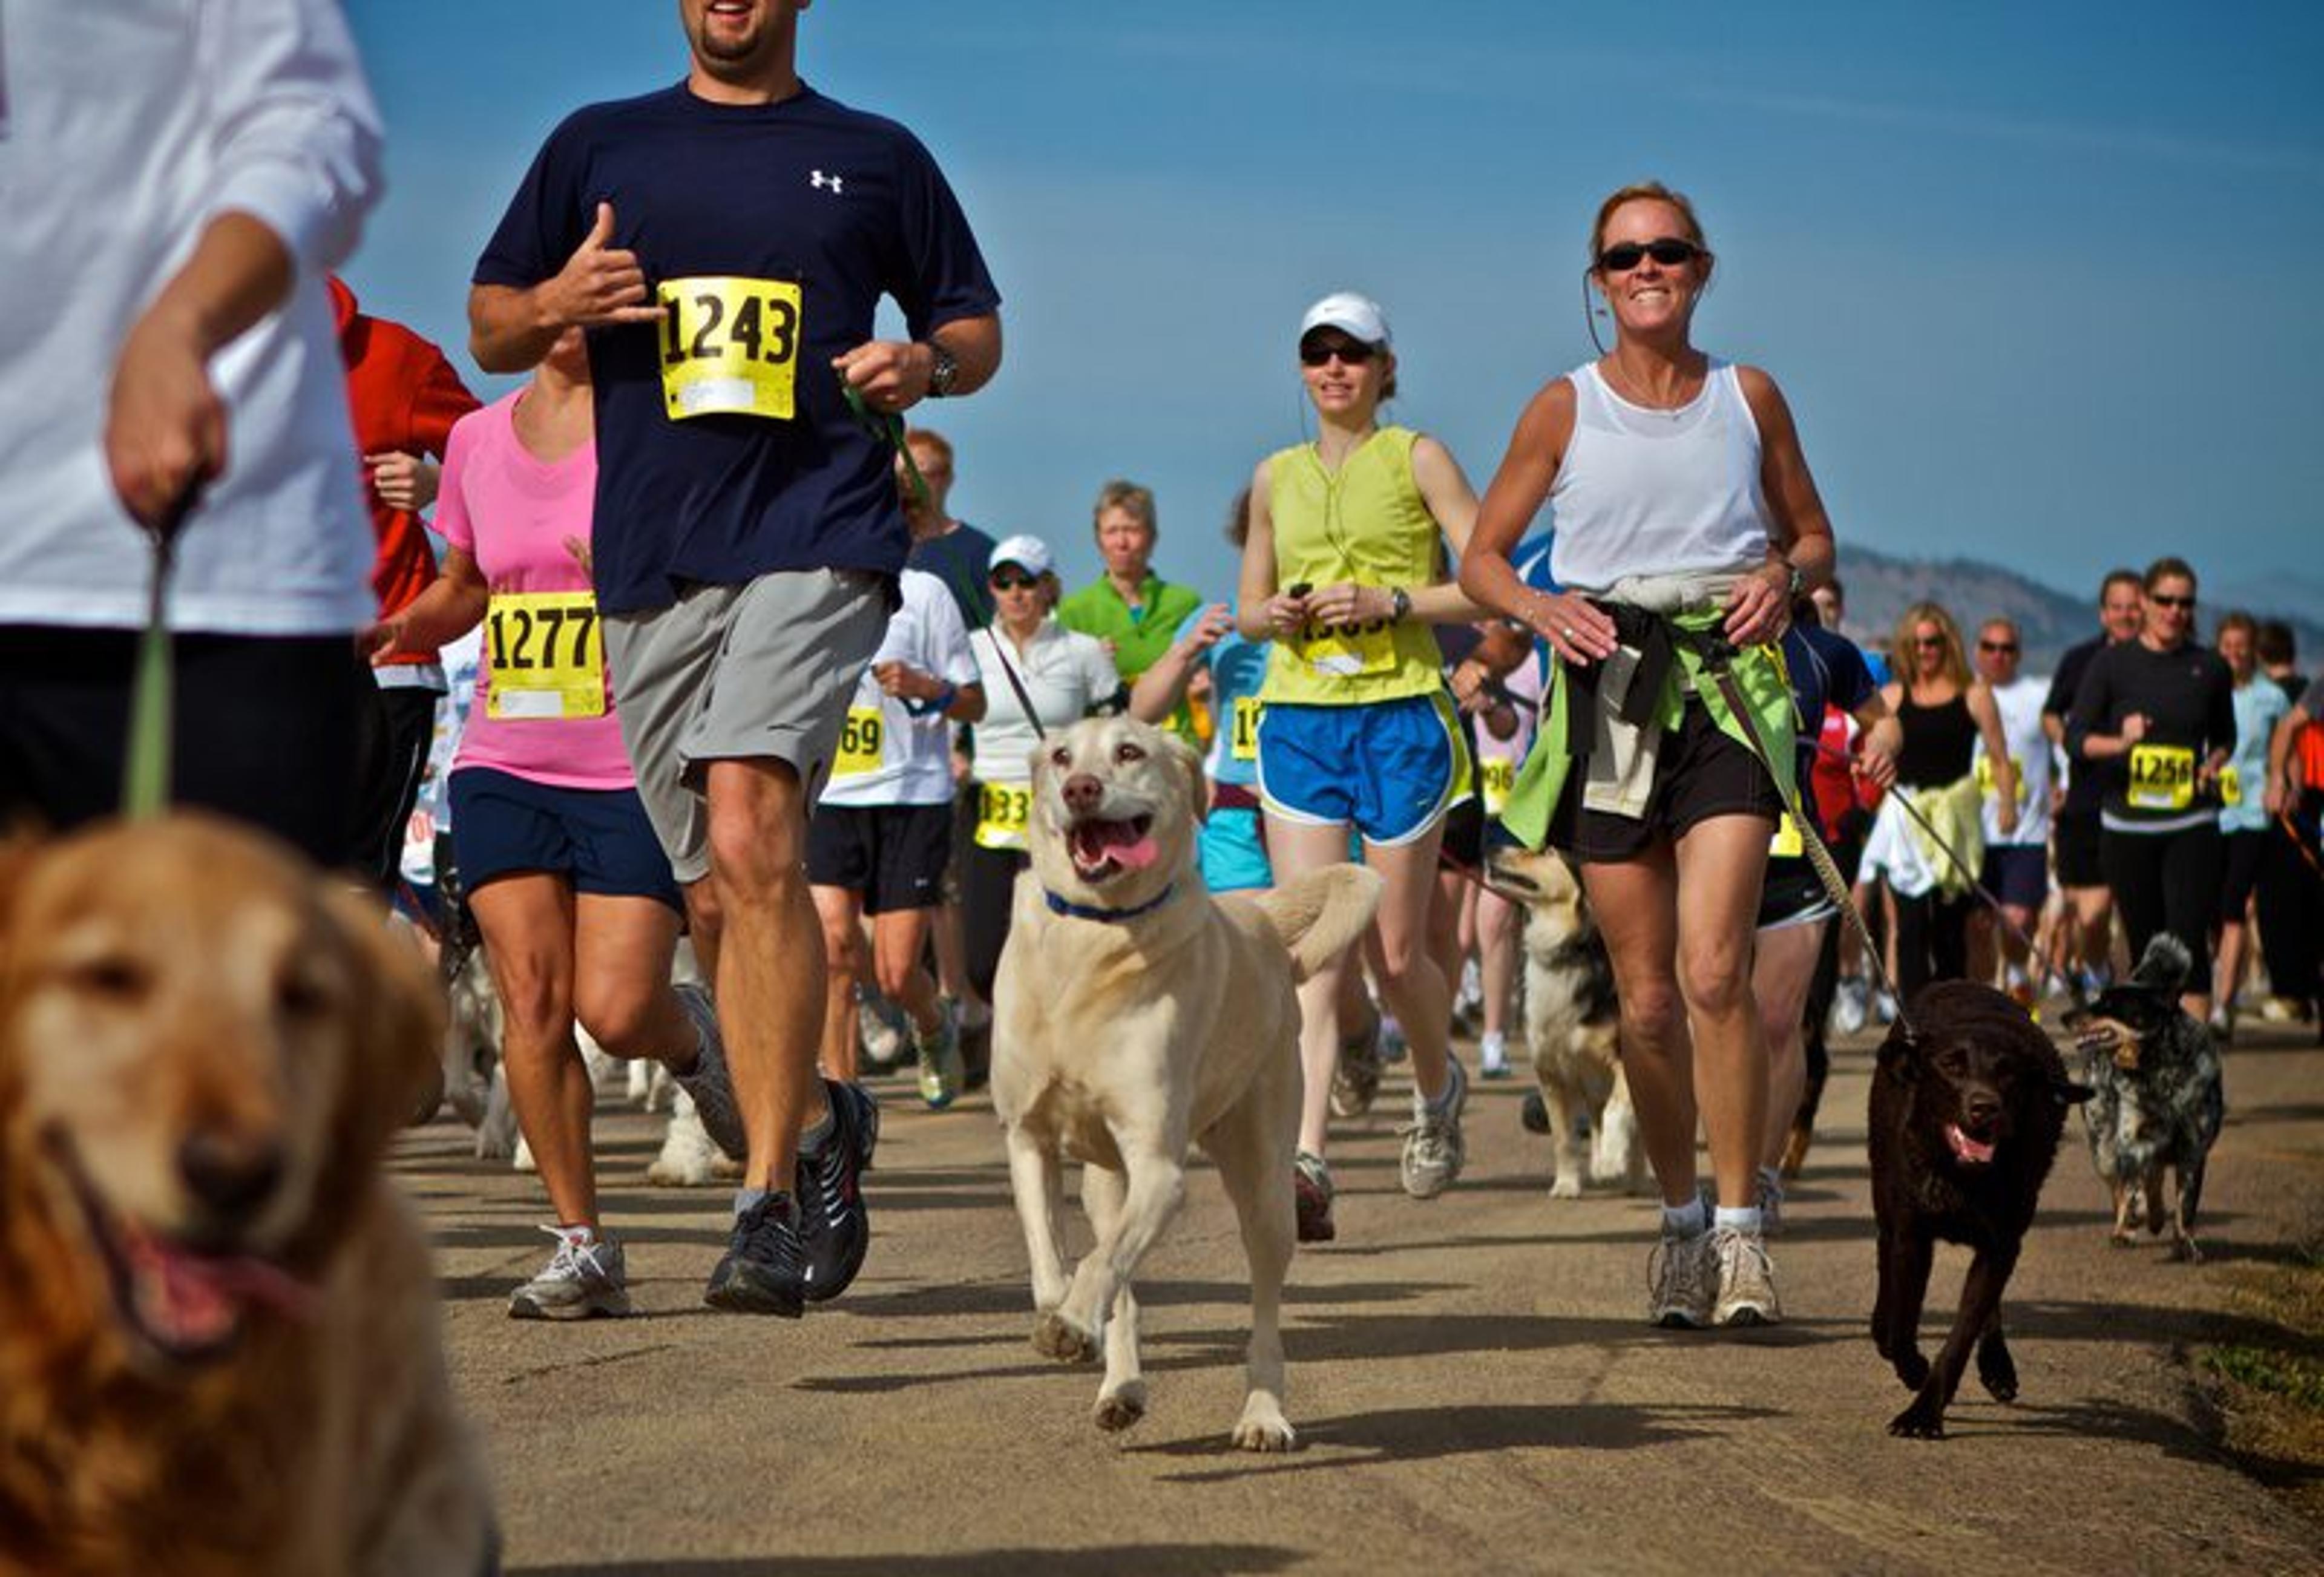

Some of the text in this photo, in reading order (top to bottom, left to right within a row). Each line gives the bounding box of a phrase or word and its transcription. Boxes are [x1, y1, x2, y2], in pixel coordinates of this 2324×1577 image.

[665, 294, 796, 364] 1243
[491, 607, 594, 669] 1277
[983, 790, 1034, 822] 133
